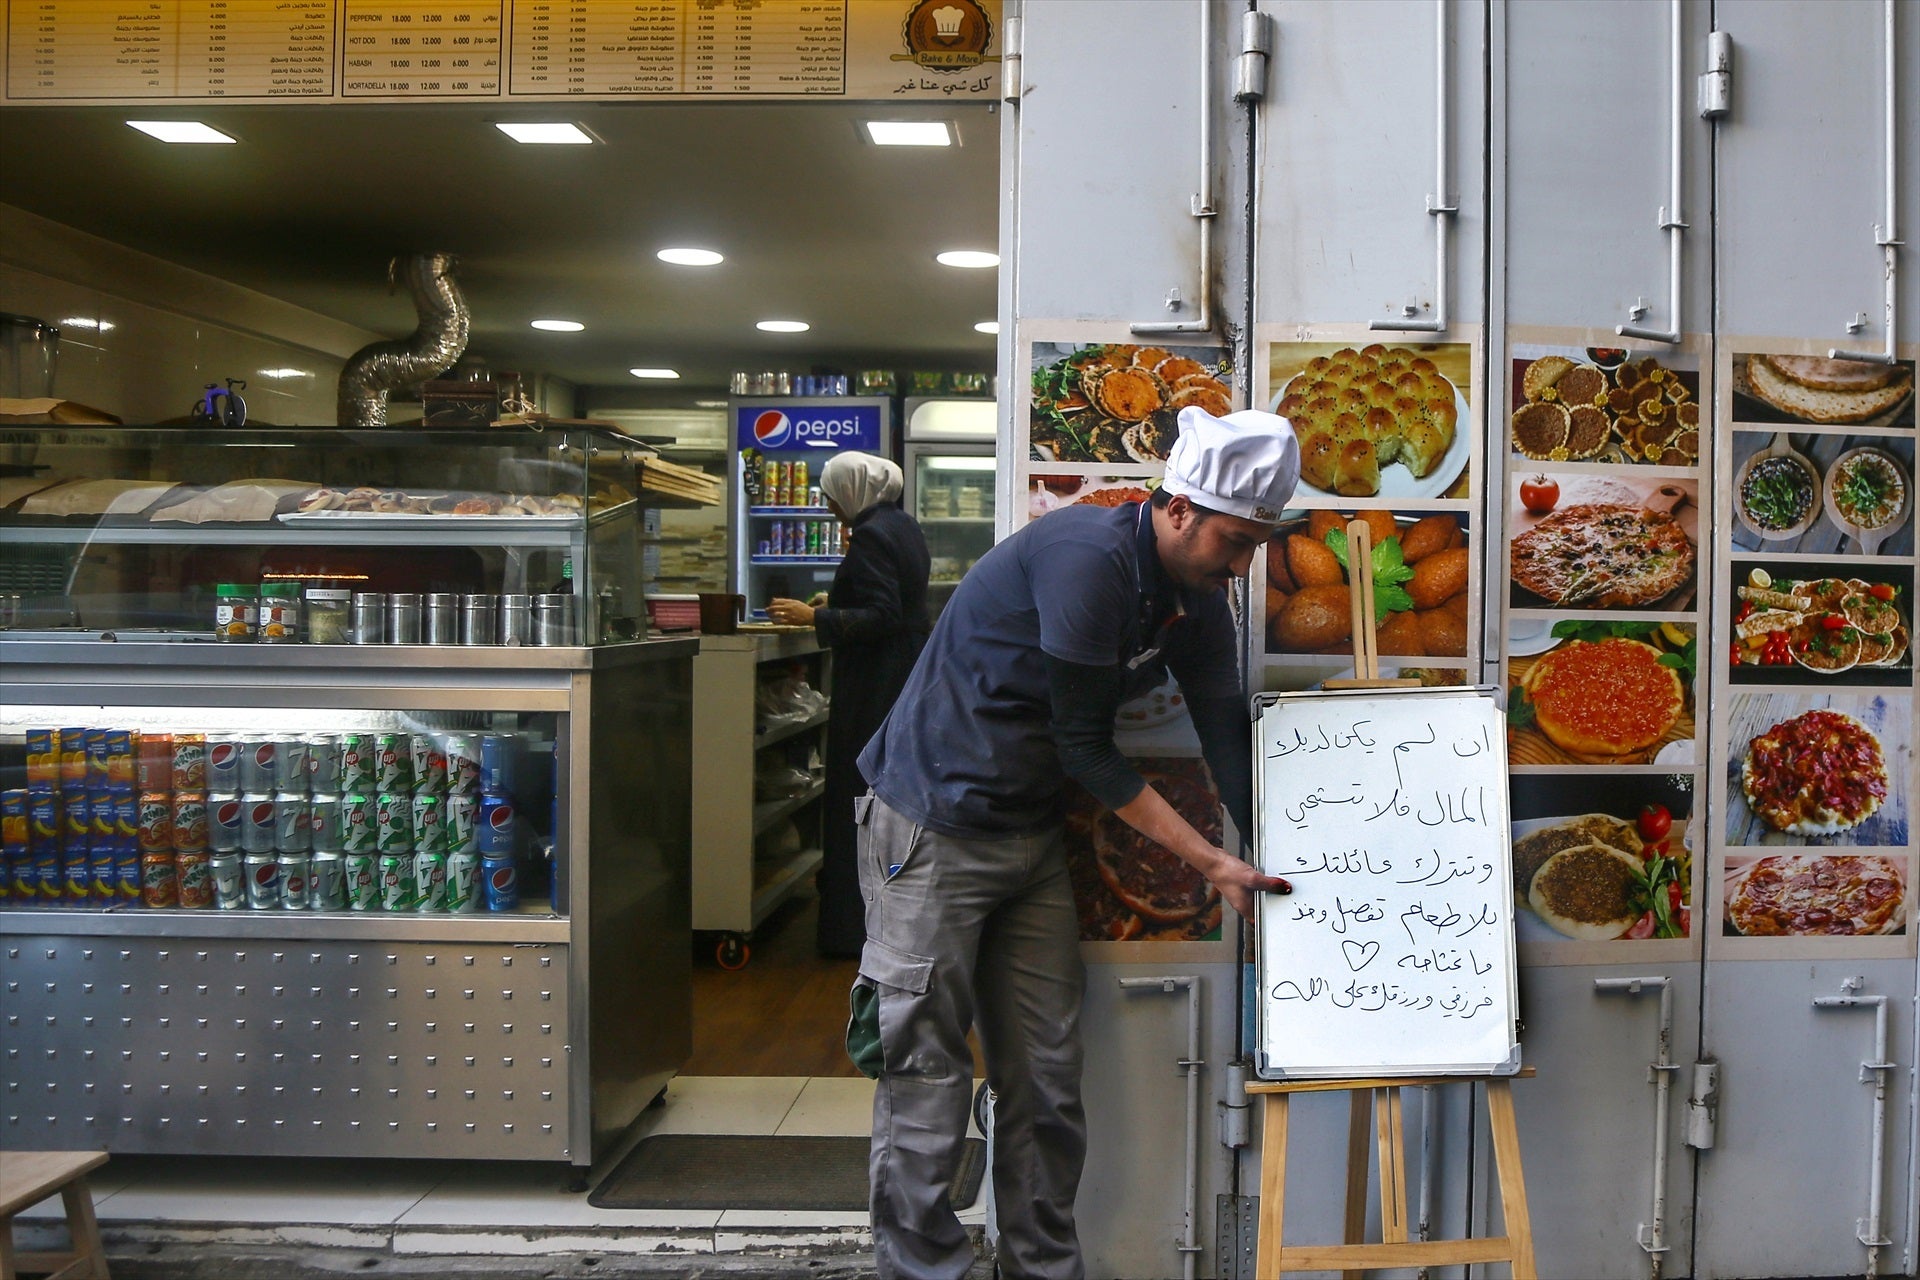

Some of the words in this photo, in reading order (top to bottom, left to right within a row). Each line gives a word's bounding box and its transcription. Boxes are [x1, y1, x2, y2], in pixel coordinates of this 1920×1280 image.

[921, 53, 943, 63] Bake
[956, 54, 979, 64] More
[893, 79, 916, 94] غير
[920, 78, 940, 90] عنا
[970, 76, 992, 92] كل
[796, 416, 860, 440] pepsi
[1334, 720, 1375, 754] يكن
[1453, 724, 1490, 758] ان
[1393, 722, 1436, 789] لم
[1364, 787, 1410, 822] فلا
[1417, 786, 1487, 826] المال
[1278, 848, 1393, 876] عائلتك
[1291, 901, 1328, 923] وخذ
[1400, 900, 1462, 945] طعام
[1459, 903, 1497, 936] بلا
[1469, 949, 1492, 976] ما
[1271, 979, 1330, 1002] الله
[1361, 984, 1433, 1011] ورزقك
